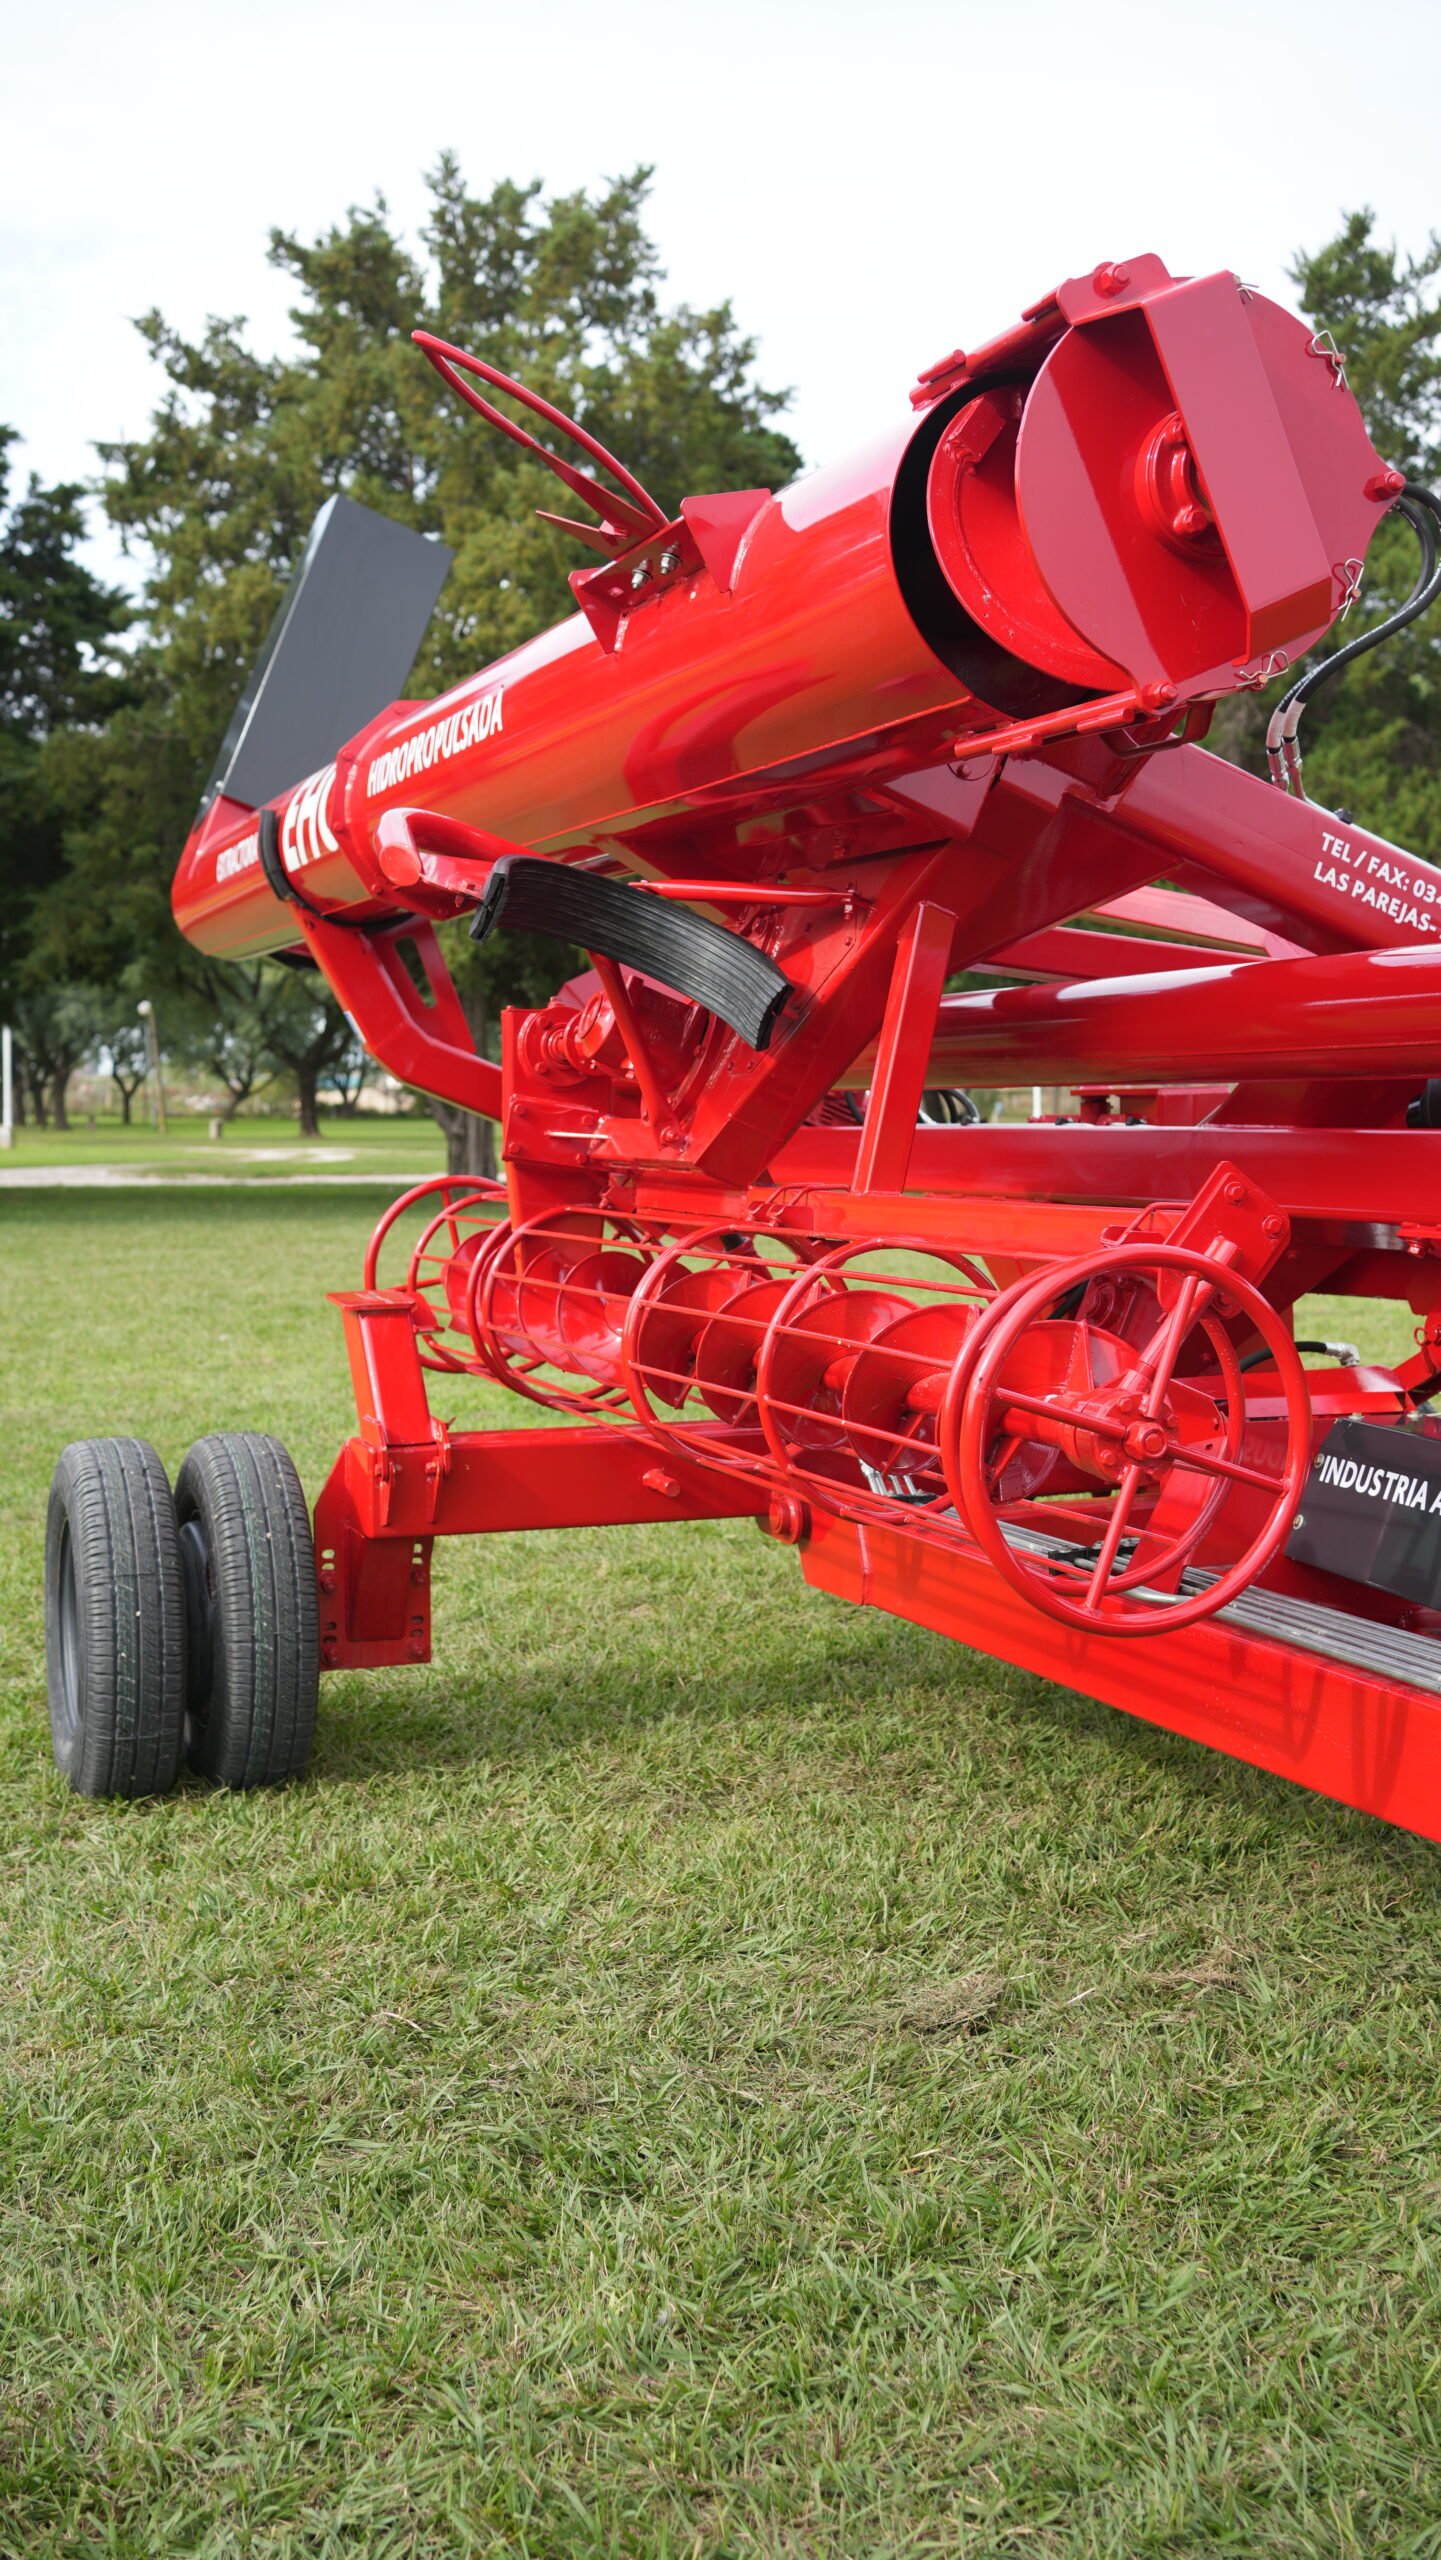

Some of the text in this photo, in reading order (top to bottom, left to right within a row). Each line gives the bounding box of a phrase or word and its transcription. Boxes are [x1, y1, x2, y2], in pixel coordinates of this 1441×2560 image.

[367, 688, 504, 797] HIDROPROPULSADA
[1314, 861, 1350, 891] LAS
[1322, 832, 1351, 863] TEL
[1367, 856, 1410, 892] FAX:
[1319, 1455, 1429, 1511] INDUSTRIA
